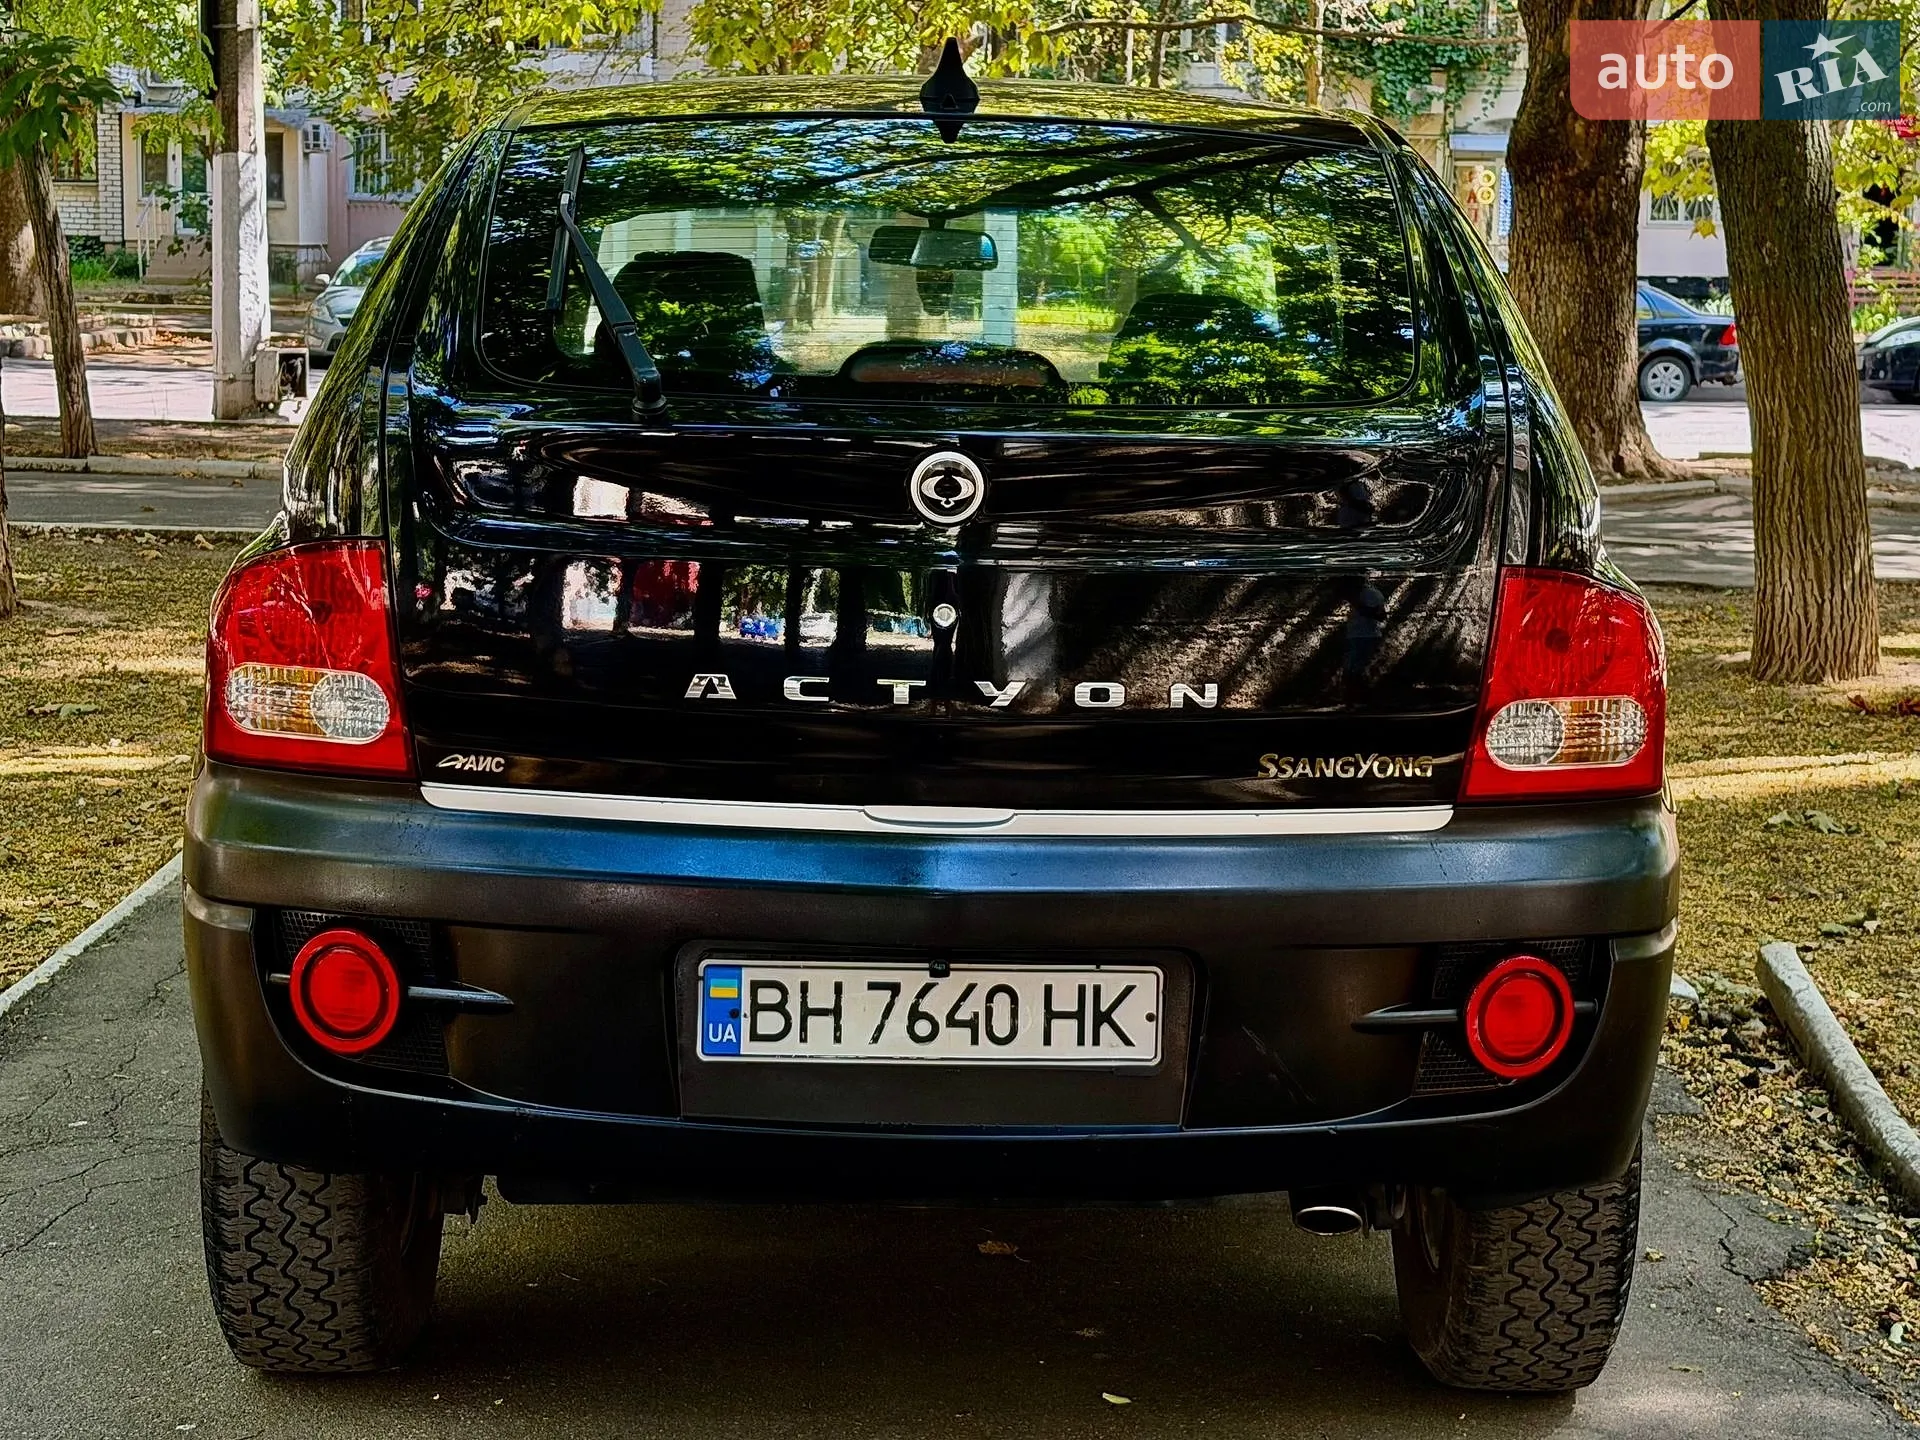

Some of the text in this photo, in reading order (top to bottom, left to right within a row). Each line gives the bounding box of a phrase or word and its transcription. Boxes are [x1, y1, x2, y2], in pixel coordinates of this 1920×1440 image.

[684, 673, 1218, 709] ACTYON
[749, 979, 1138, 1047] BH 7640 HK
[708, 1023, 737, 1043] UA
